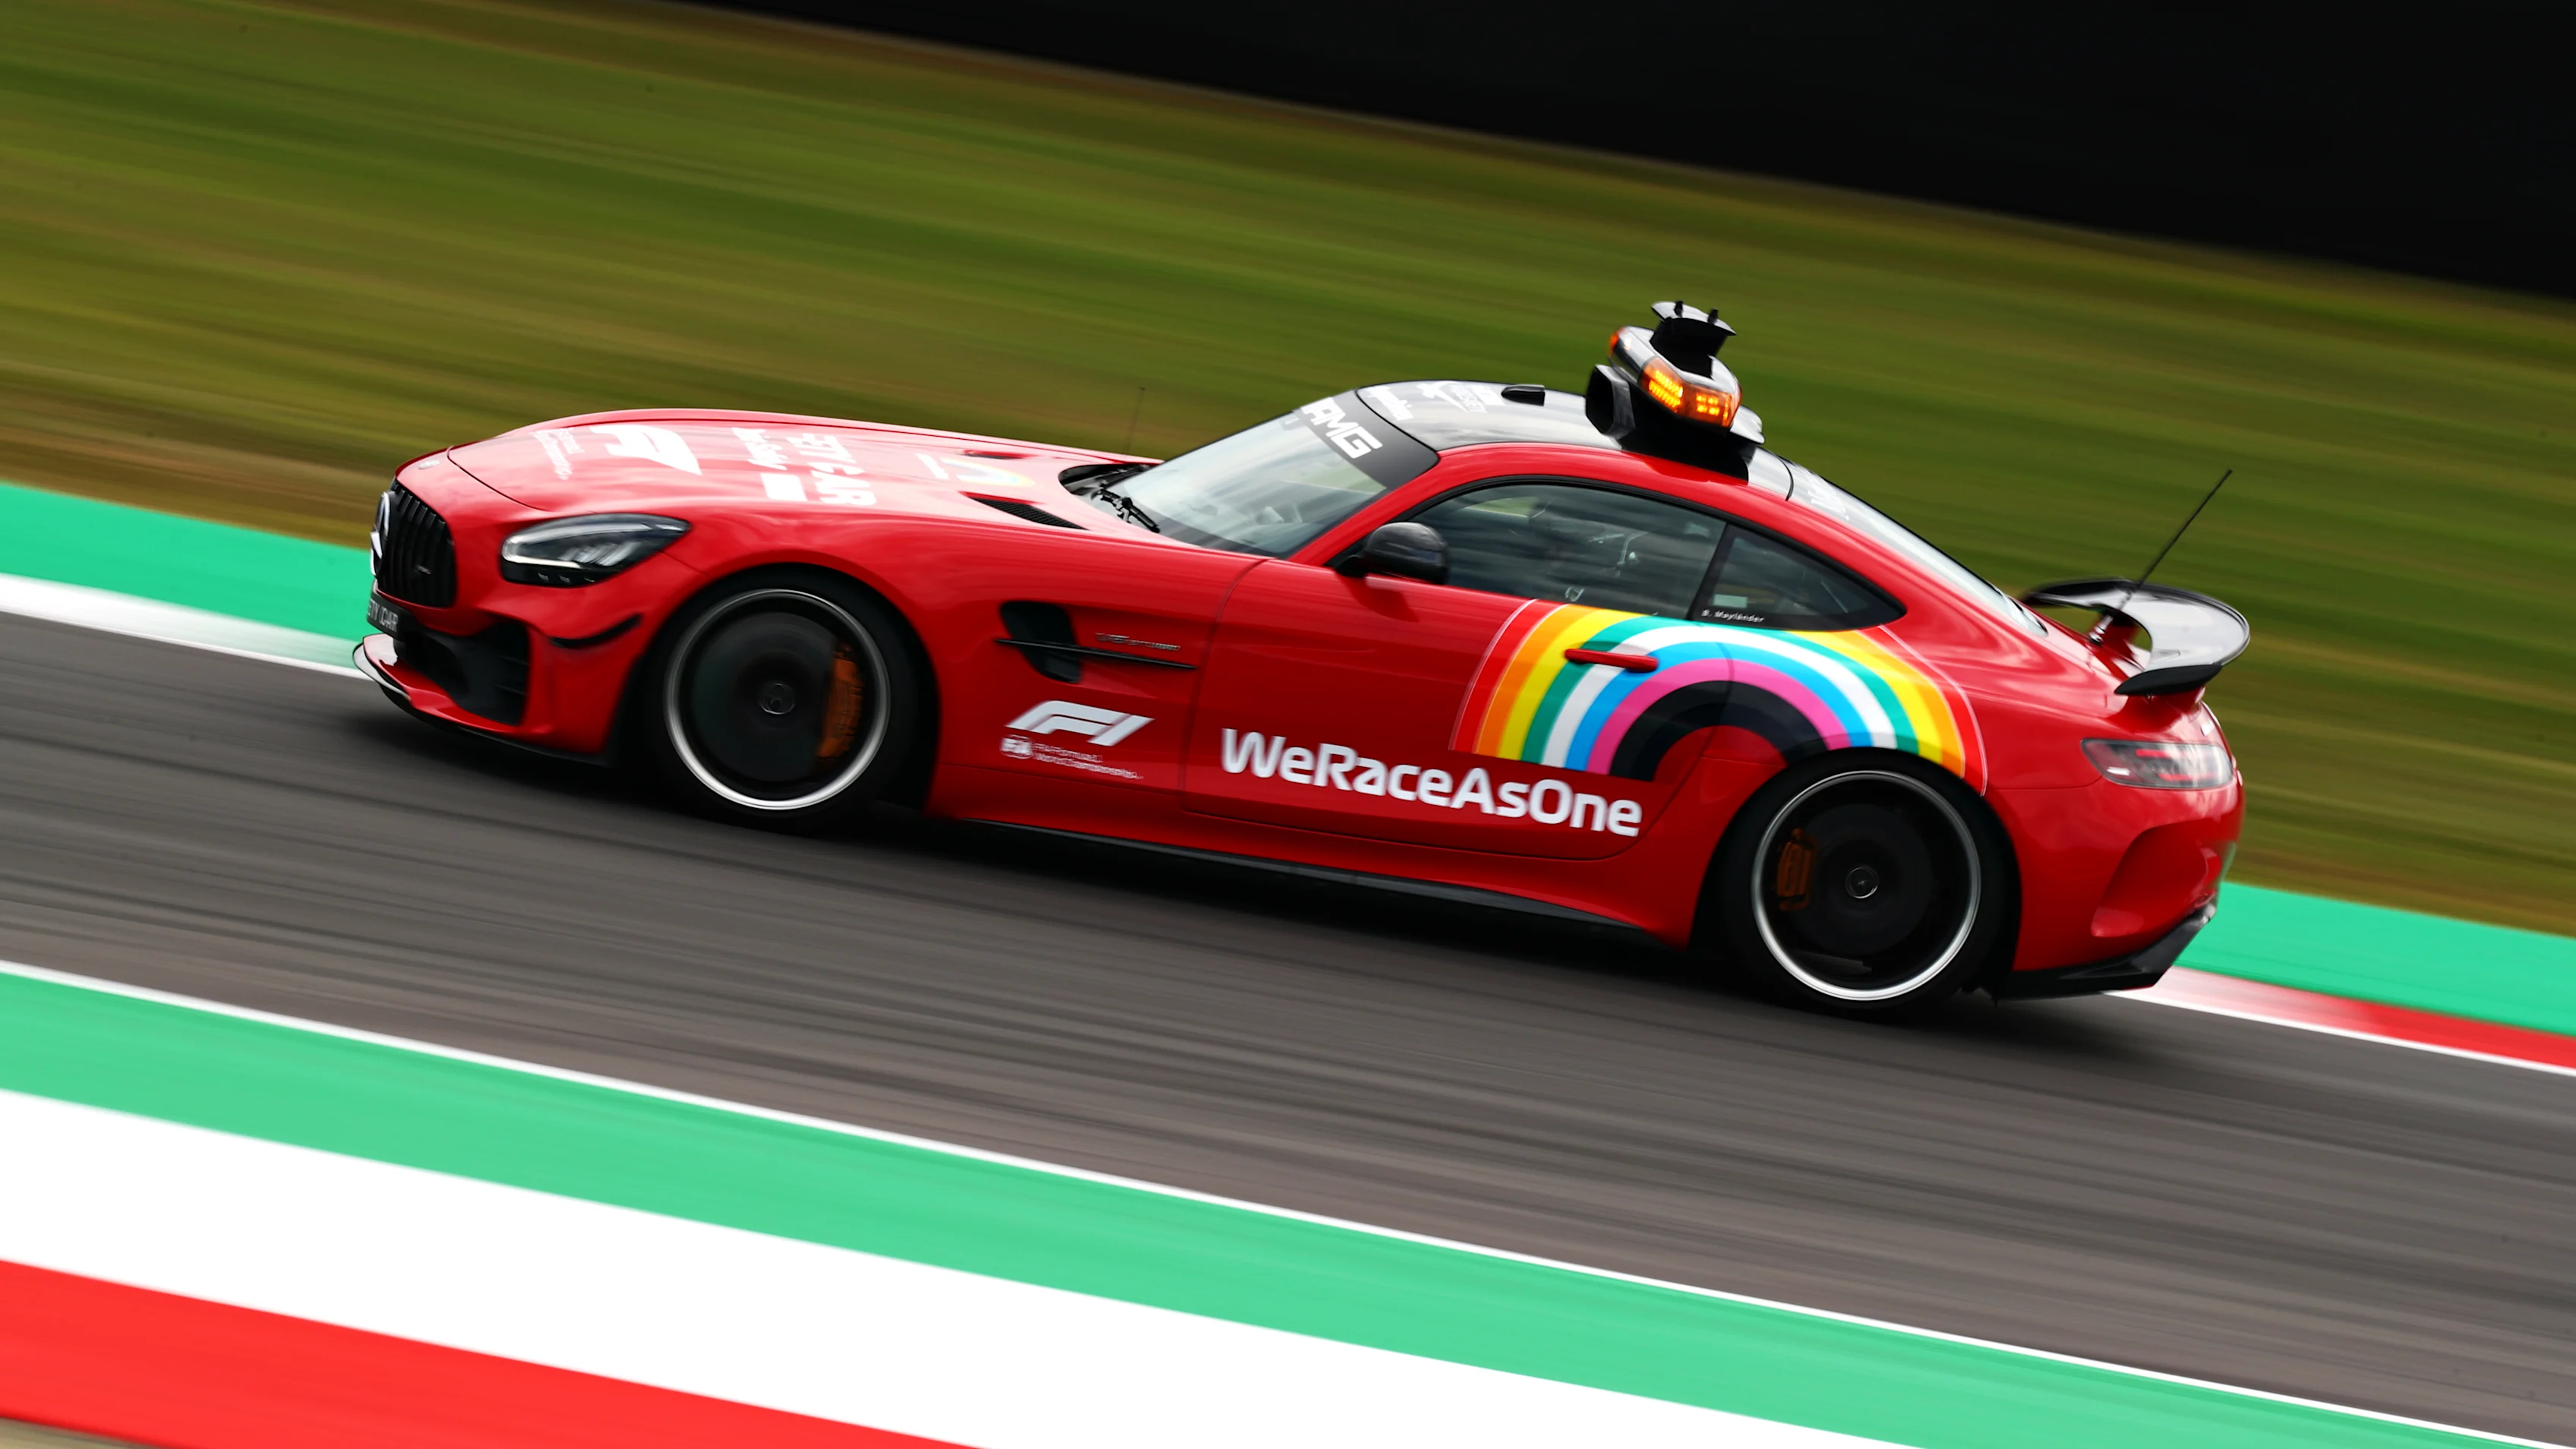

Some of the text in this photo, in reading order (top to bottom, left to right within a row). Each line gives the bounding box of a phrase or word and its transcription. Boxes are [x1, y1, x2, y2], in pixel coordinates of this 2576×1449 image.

[1299, 397, 1383, 459] AMG
[807, 462, 878, 506] CAR
[1004, 699, 1155, 747] F1
[1222, 728, 1642, 838] WeRaceAsOne
